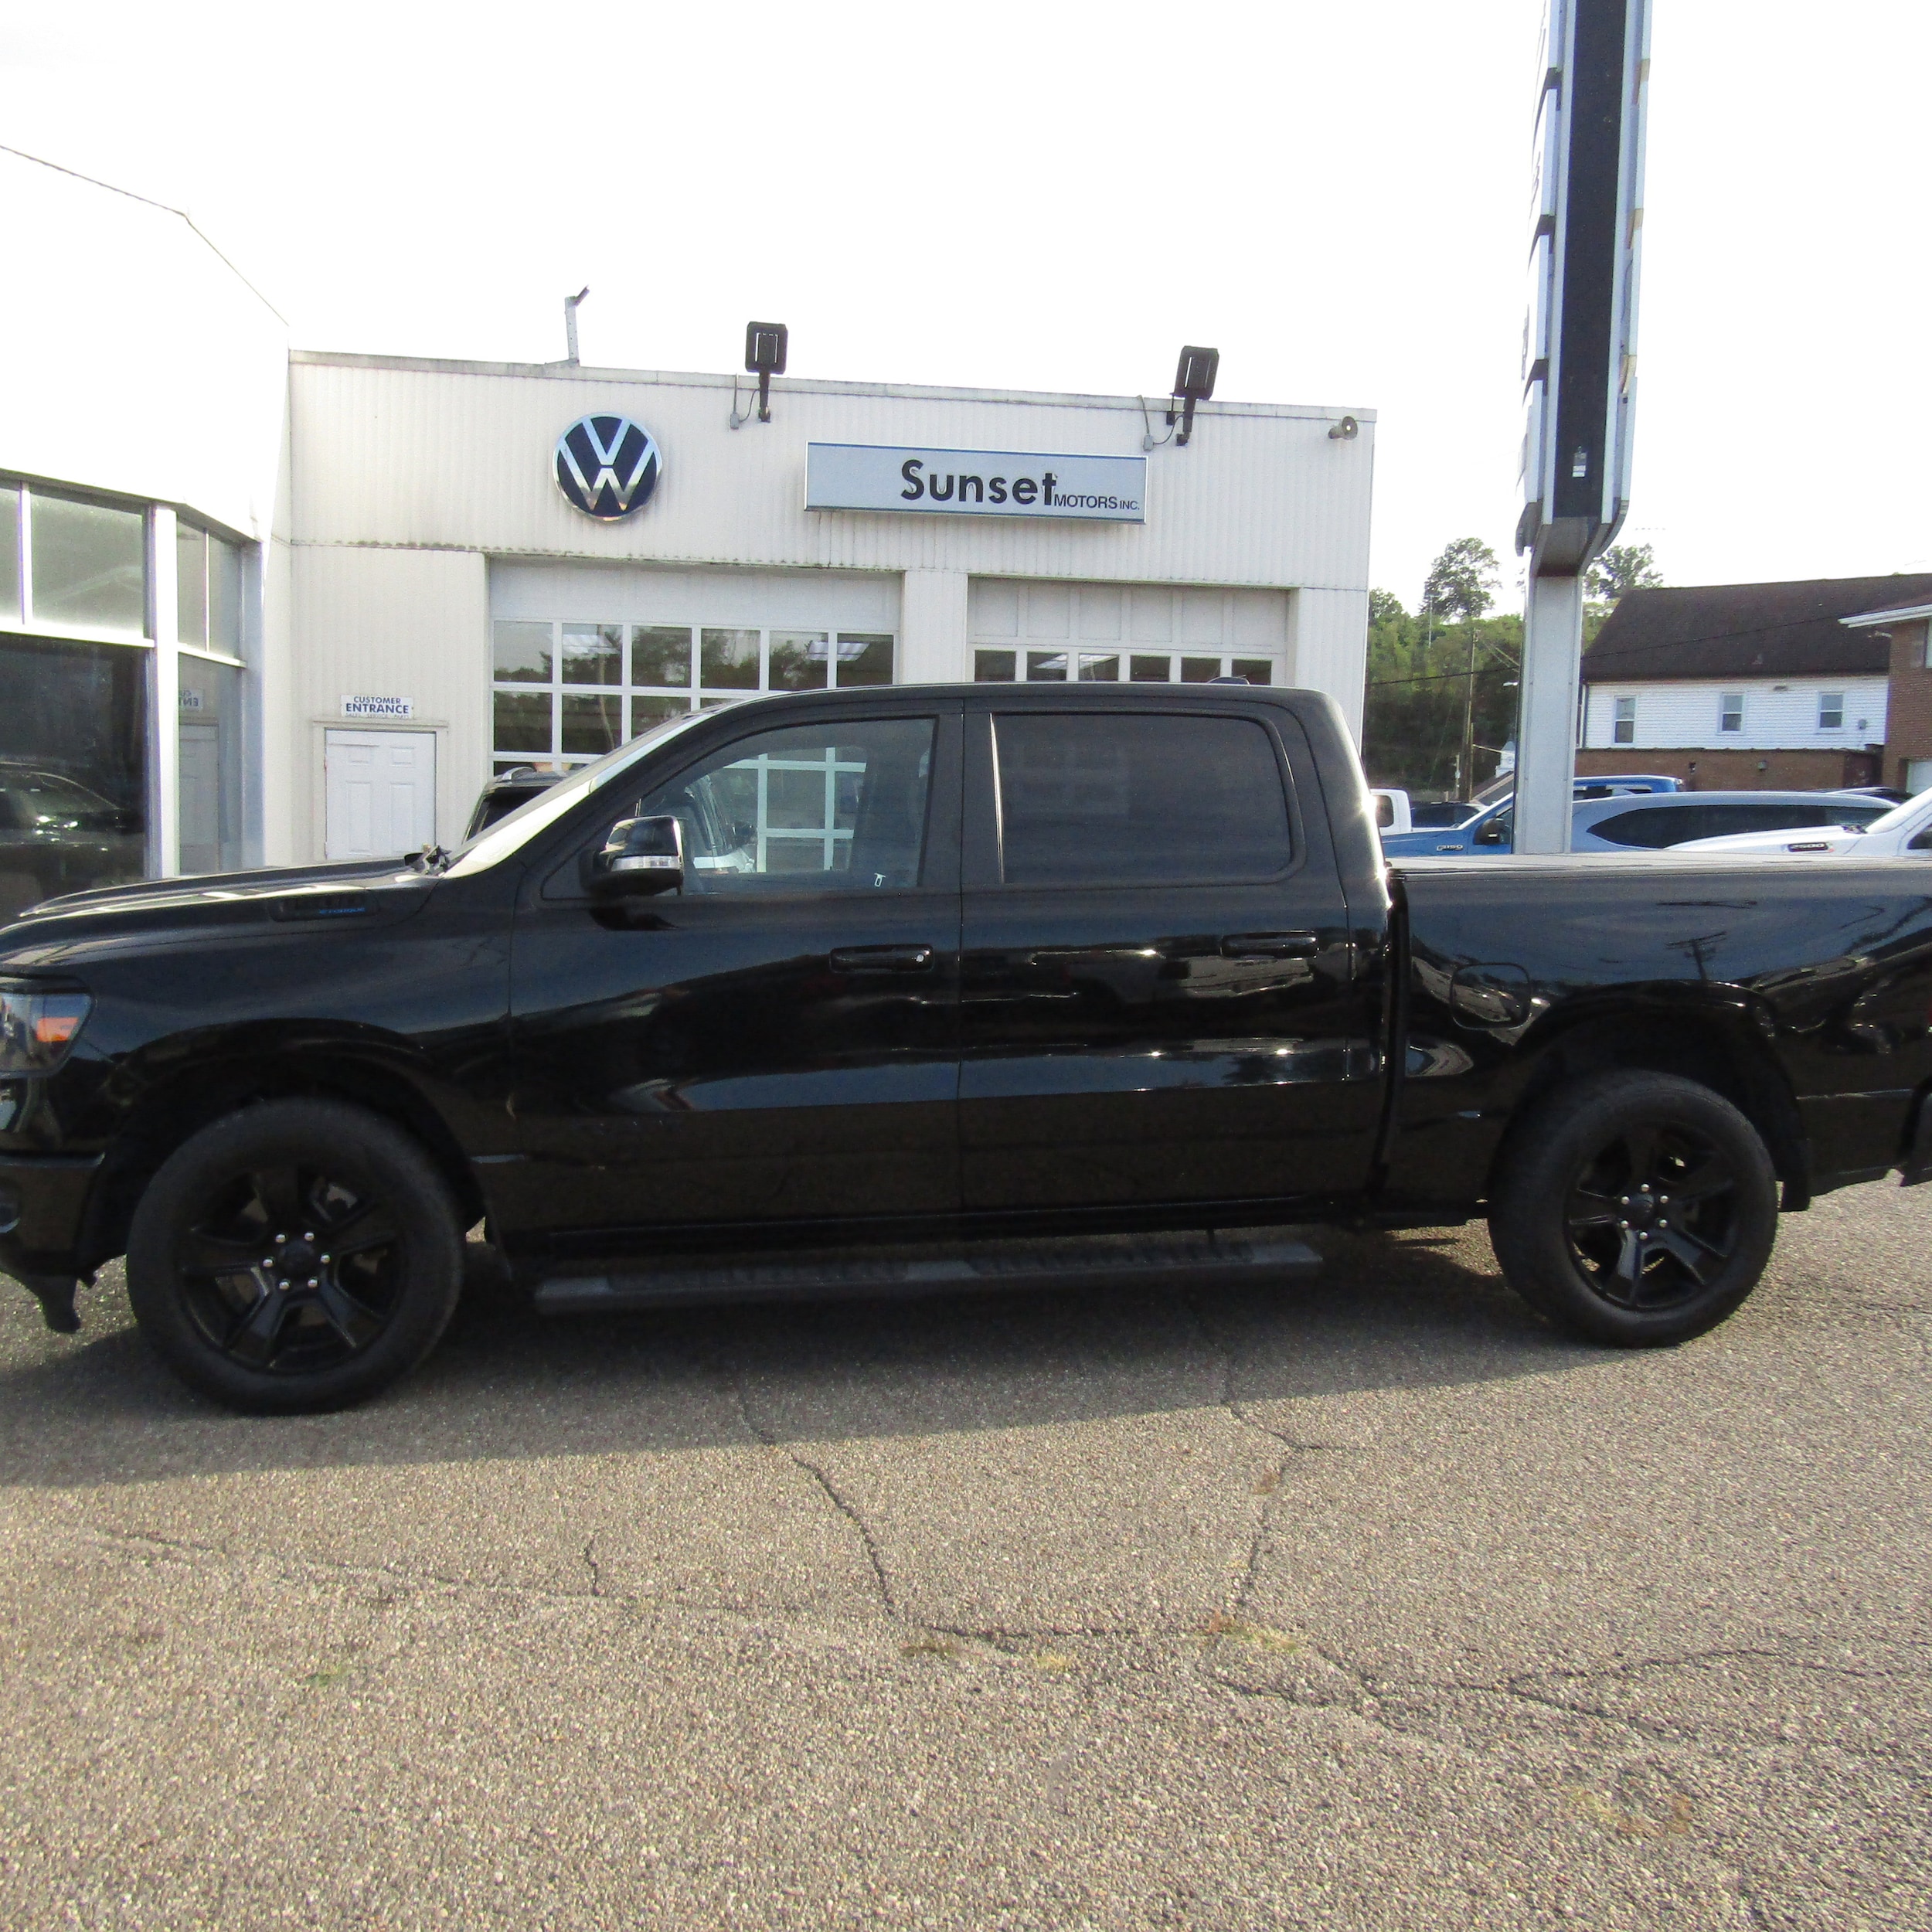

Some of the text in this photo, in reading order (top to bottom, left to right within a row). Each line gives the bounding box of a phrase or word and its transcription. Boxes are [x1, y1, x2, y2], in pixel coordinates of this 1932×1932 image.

[900, 458, 1140, 510] Sunset MOTORS INC.
[346, 703, 409, 713] ENTRANCE
